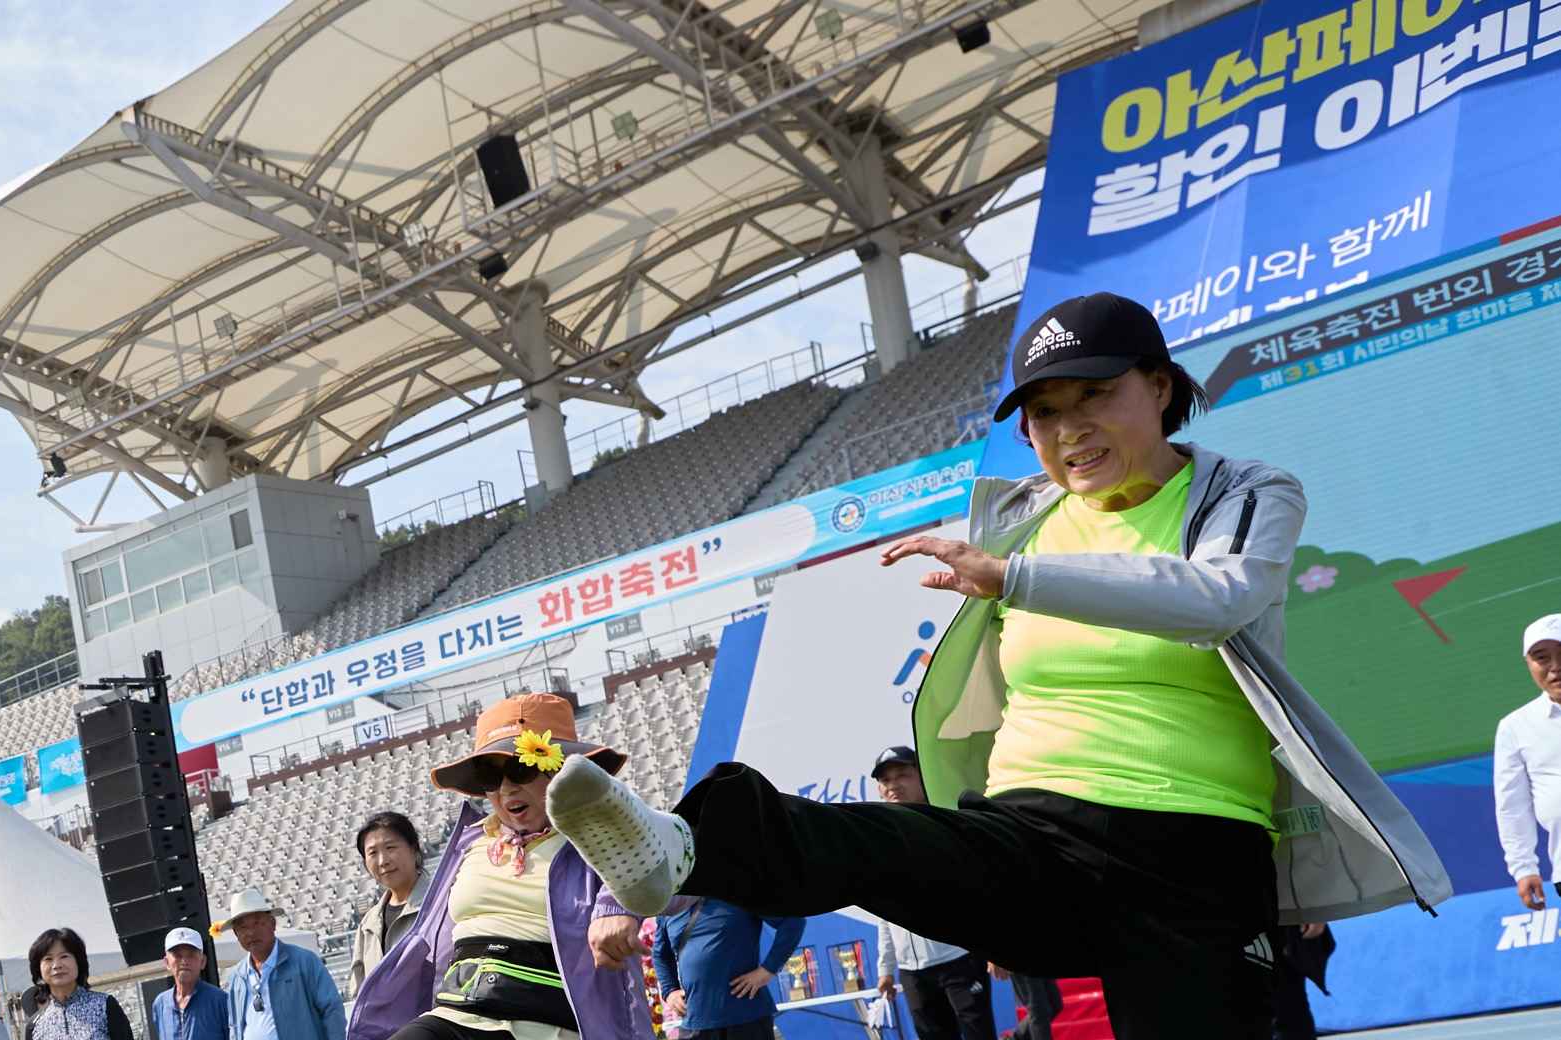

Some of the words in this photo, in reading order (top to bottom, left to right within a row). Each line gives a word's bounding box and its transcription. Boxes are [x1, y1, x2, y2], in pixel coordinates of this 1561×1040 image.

[1087, 104, 1287, 236] 할인
[1329, 190, 1432, 268] 함께
[1028, 331, 1074, 356] adidas
[1249, 299, 1401, 366] 체육축전
[1412, 269, 1494, 315] 번외
[347, 640, 425, 687] 우정을
[439, 614, 524, 660] 다지는
[362, 723, 382, 740] V5
[1496, 907, 1559, 951] 제
